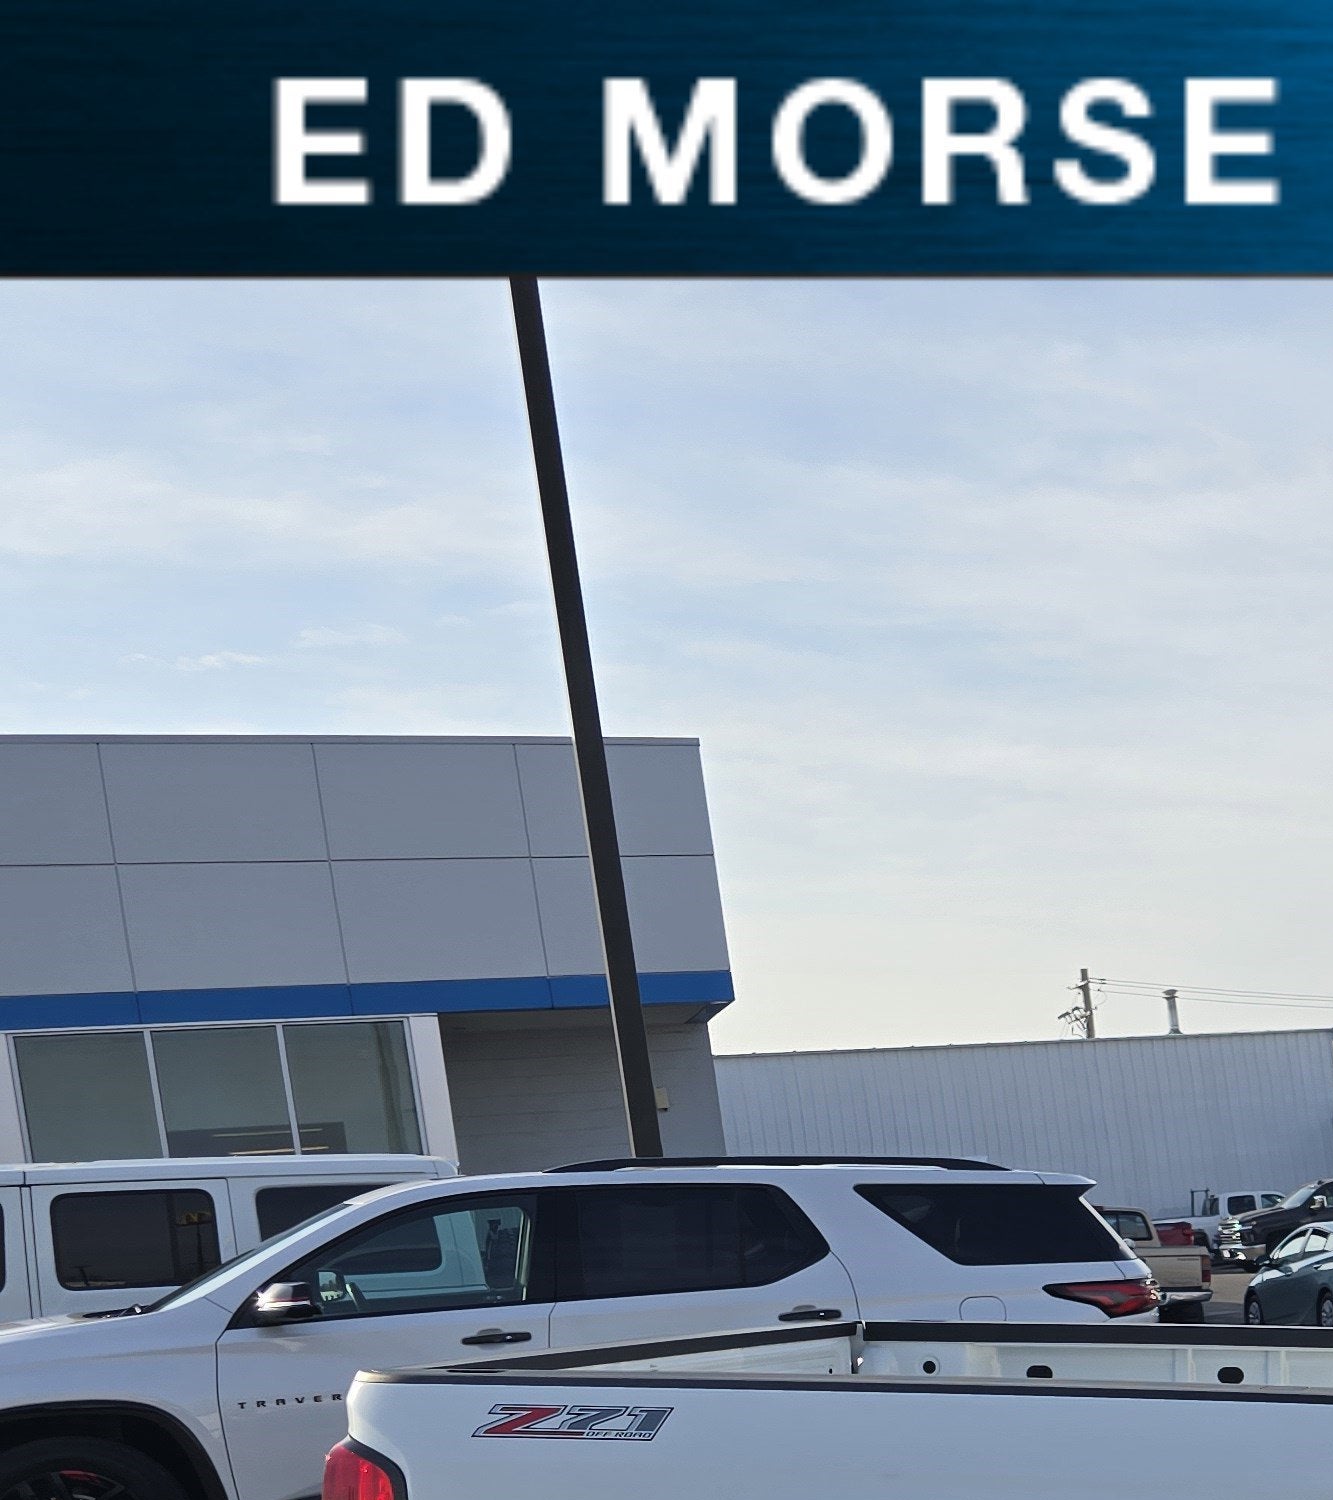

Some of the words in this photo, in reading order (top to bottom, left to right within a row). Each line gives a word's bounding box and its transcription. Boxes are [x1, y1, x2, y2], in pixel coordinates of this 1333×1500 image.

[472, 1404, 675, 1440] Z71
[585, 1430, 611, 1438] OFF
[615, 1431, 653, 1439] ROAD
